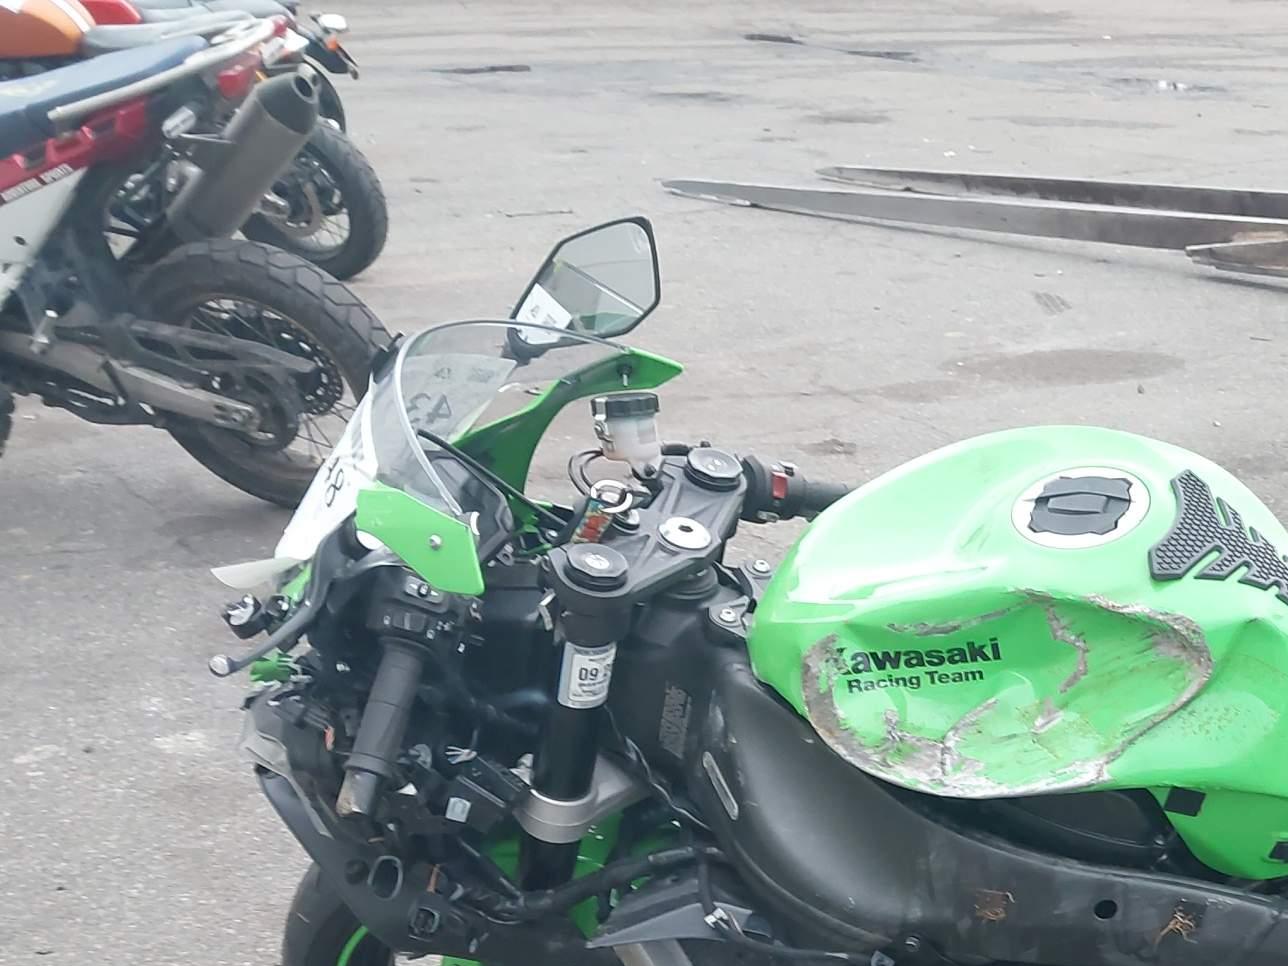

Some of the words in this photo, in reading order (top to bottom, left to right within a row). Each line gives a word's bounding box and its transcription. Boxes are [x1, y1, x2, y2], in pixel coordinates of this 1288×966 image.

[578, 667, 599, 681] 09
[846, 674, 922, 695] Racing
[924, 669, 985, 686] Team
